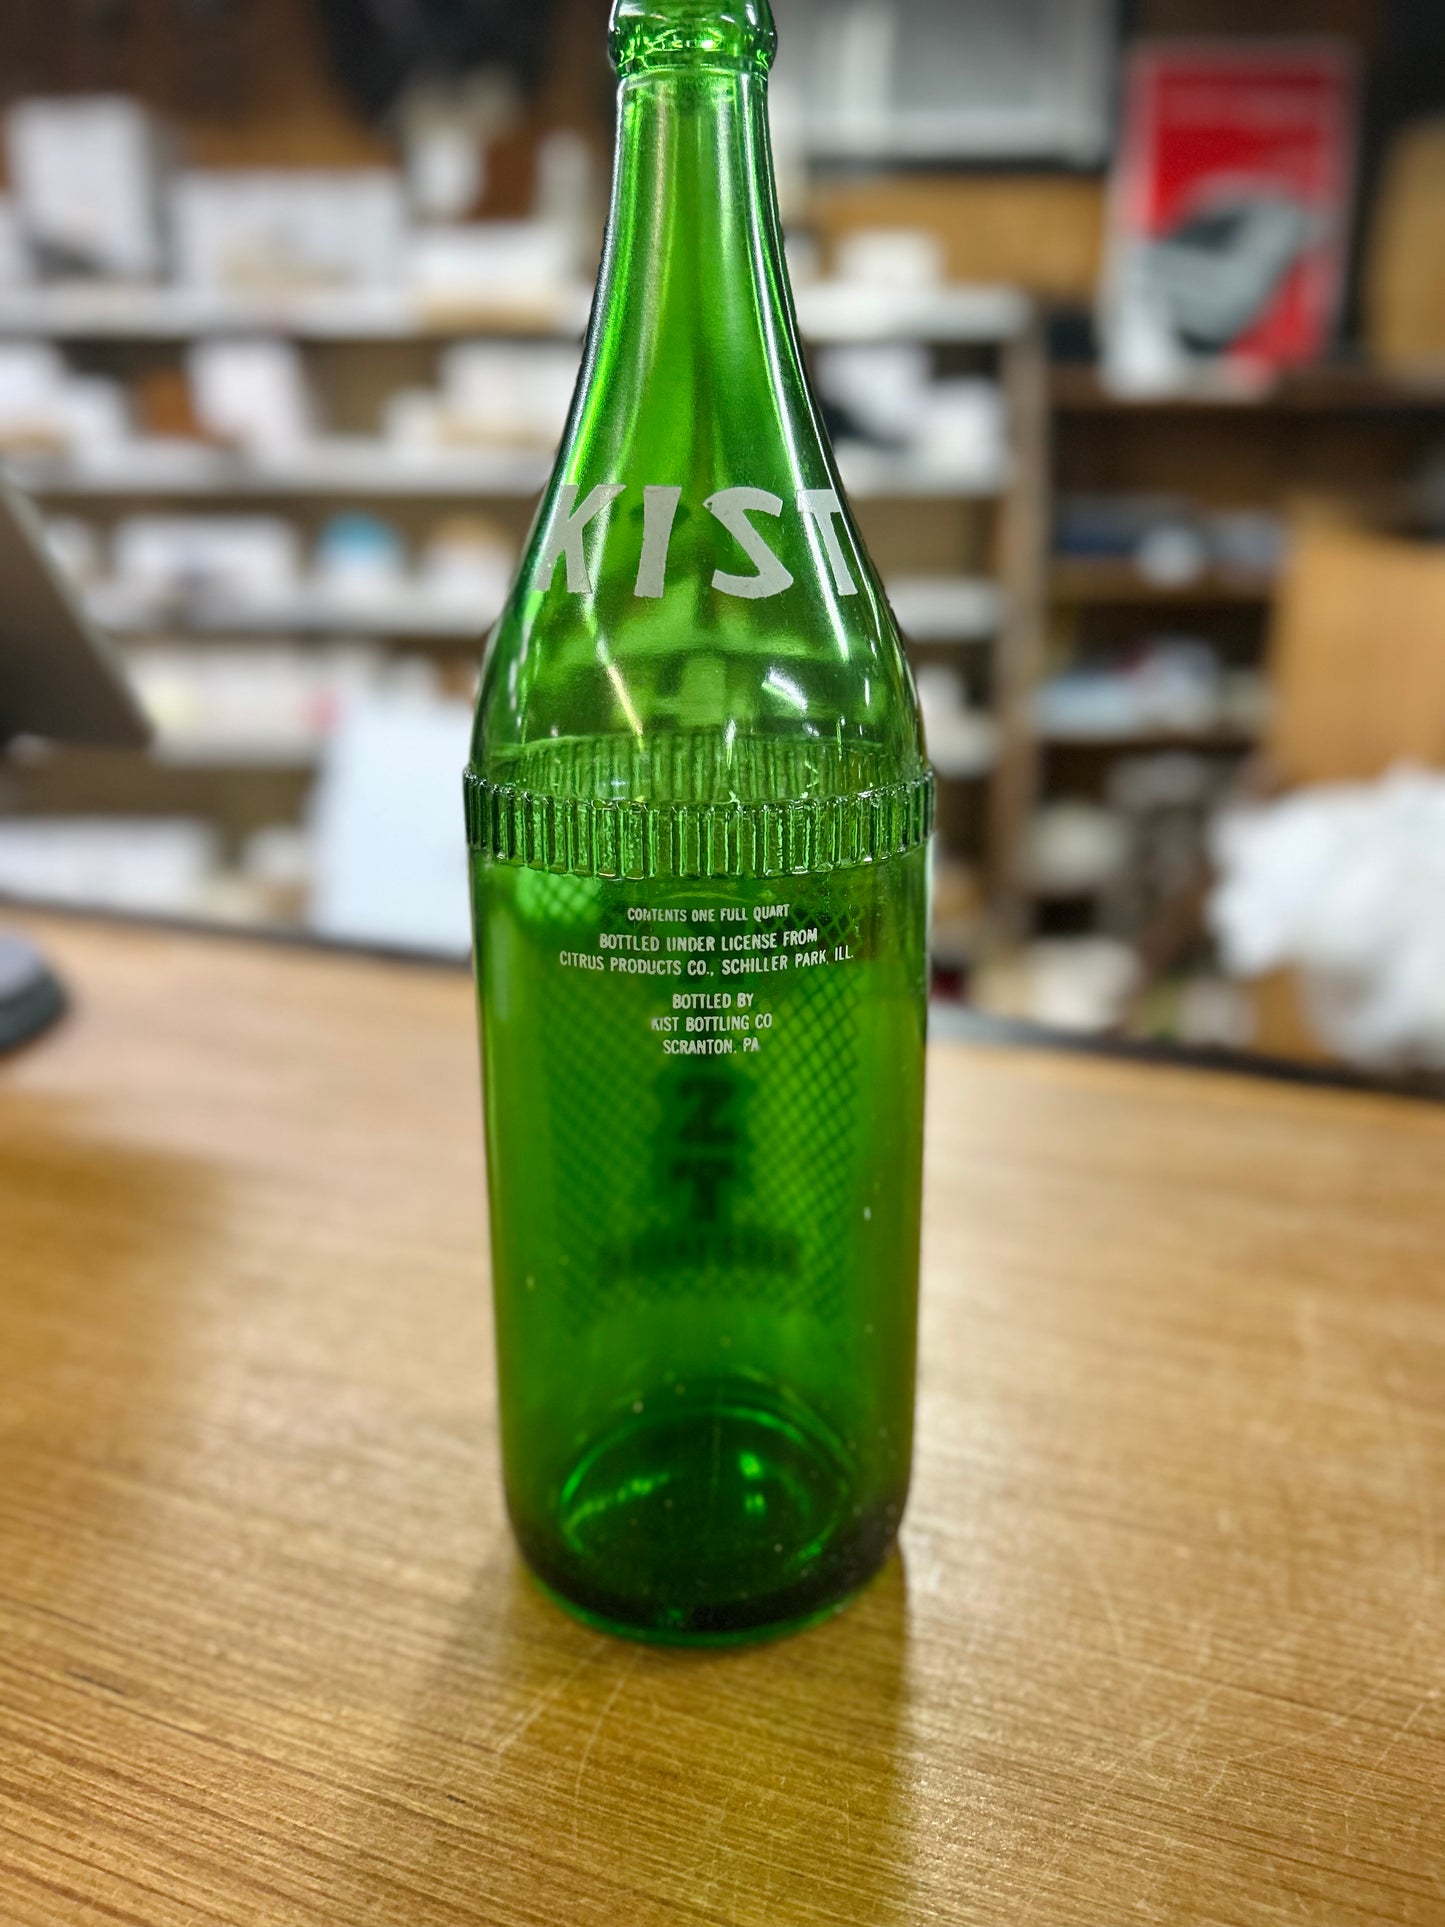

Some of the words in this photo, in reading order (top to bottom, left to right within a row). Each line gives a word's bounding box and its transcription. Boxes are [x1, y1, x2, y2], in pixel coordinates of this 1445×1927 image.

[532, 484, 858, 599] KIST
[627, 907, 687, 922] CONTENTS
[691, 908, 716, 923] ONE
[720, 907, 749, 922] FULL
[752, 903, 790, 923] QUART
[599, 933, 660, 952] BOTTLED
[666, 935, 716, 953] UNDER
[721, 932, 778, 952] LICENSE
[782, 927, 818, 947] FROM
[559, 950, 605, 971] CITRUS
[610, 956, 682, 976] PRODUCTS
[721, 954, 789, 976] SCHILLER
[672, 992, 732, 1010] BOTTLED
[736, 992, 754, 1008] BY
[651, 1016, 680, 1032] KIST
[685, 1014, 750, 1033] BOTTLING
[754, 1012, 773, 1030] CO
